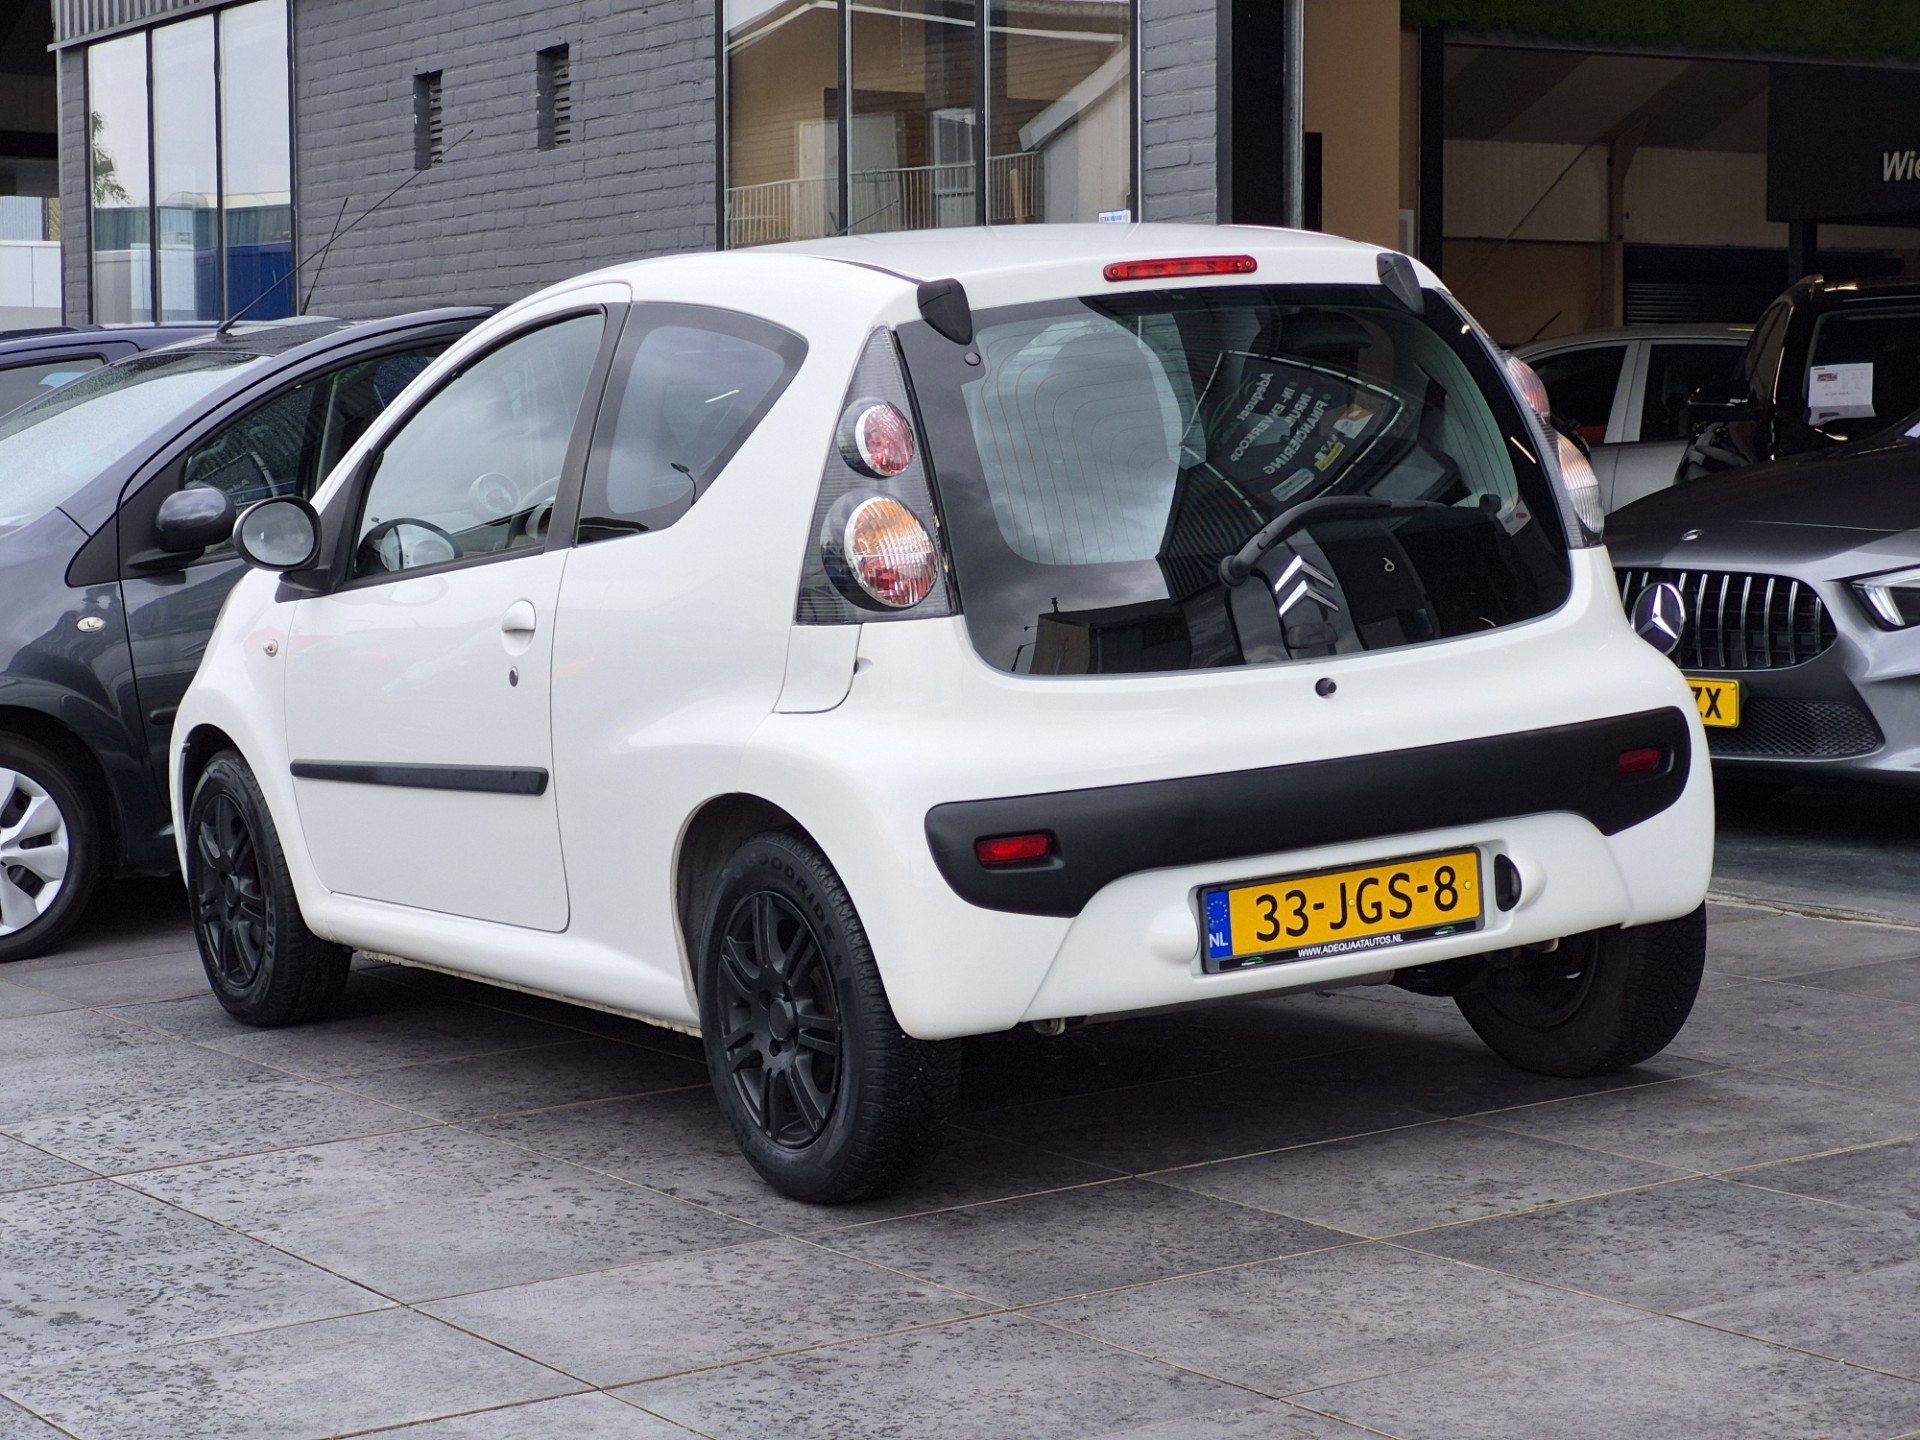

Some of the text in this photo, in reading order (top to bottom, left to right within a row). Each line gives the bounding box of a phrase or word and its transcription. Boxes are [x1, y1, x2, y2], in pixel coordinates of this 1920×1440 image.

[1254, 864, 1459, 943] 33-JGS-8
[1208, 932, 1229, 949] NL
[1297, 933, 1403, 959] WWW.ADEQUAATAUTOS.NL
